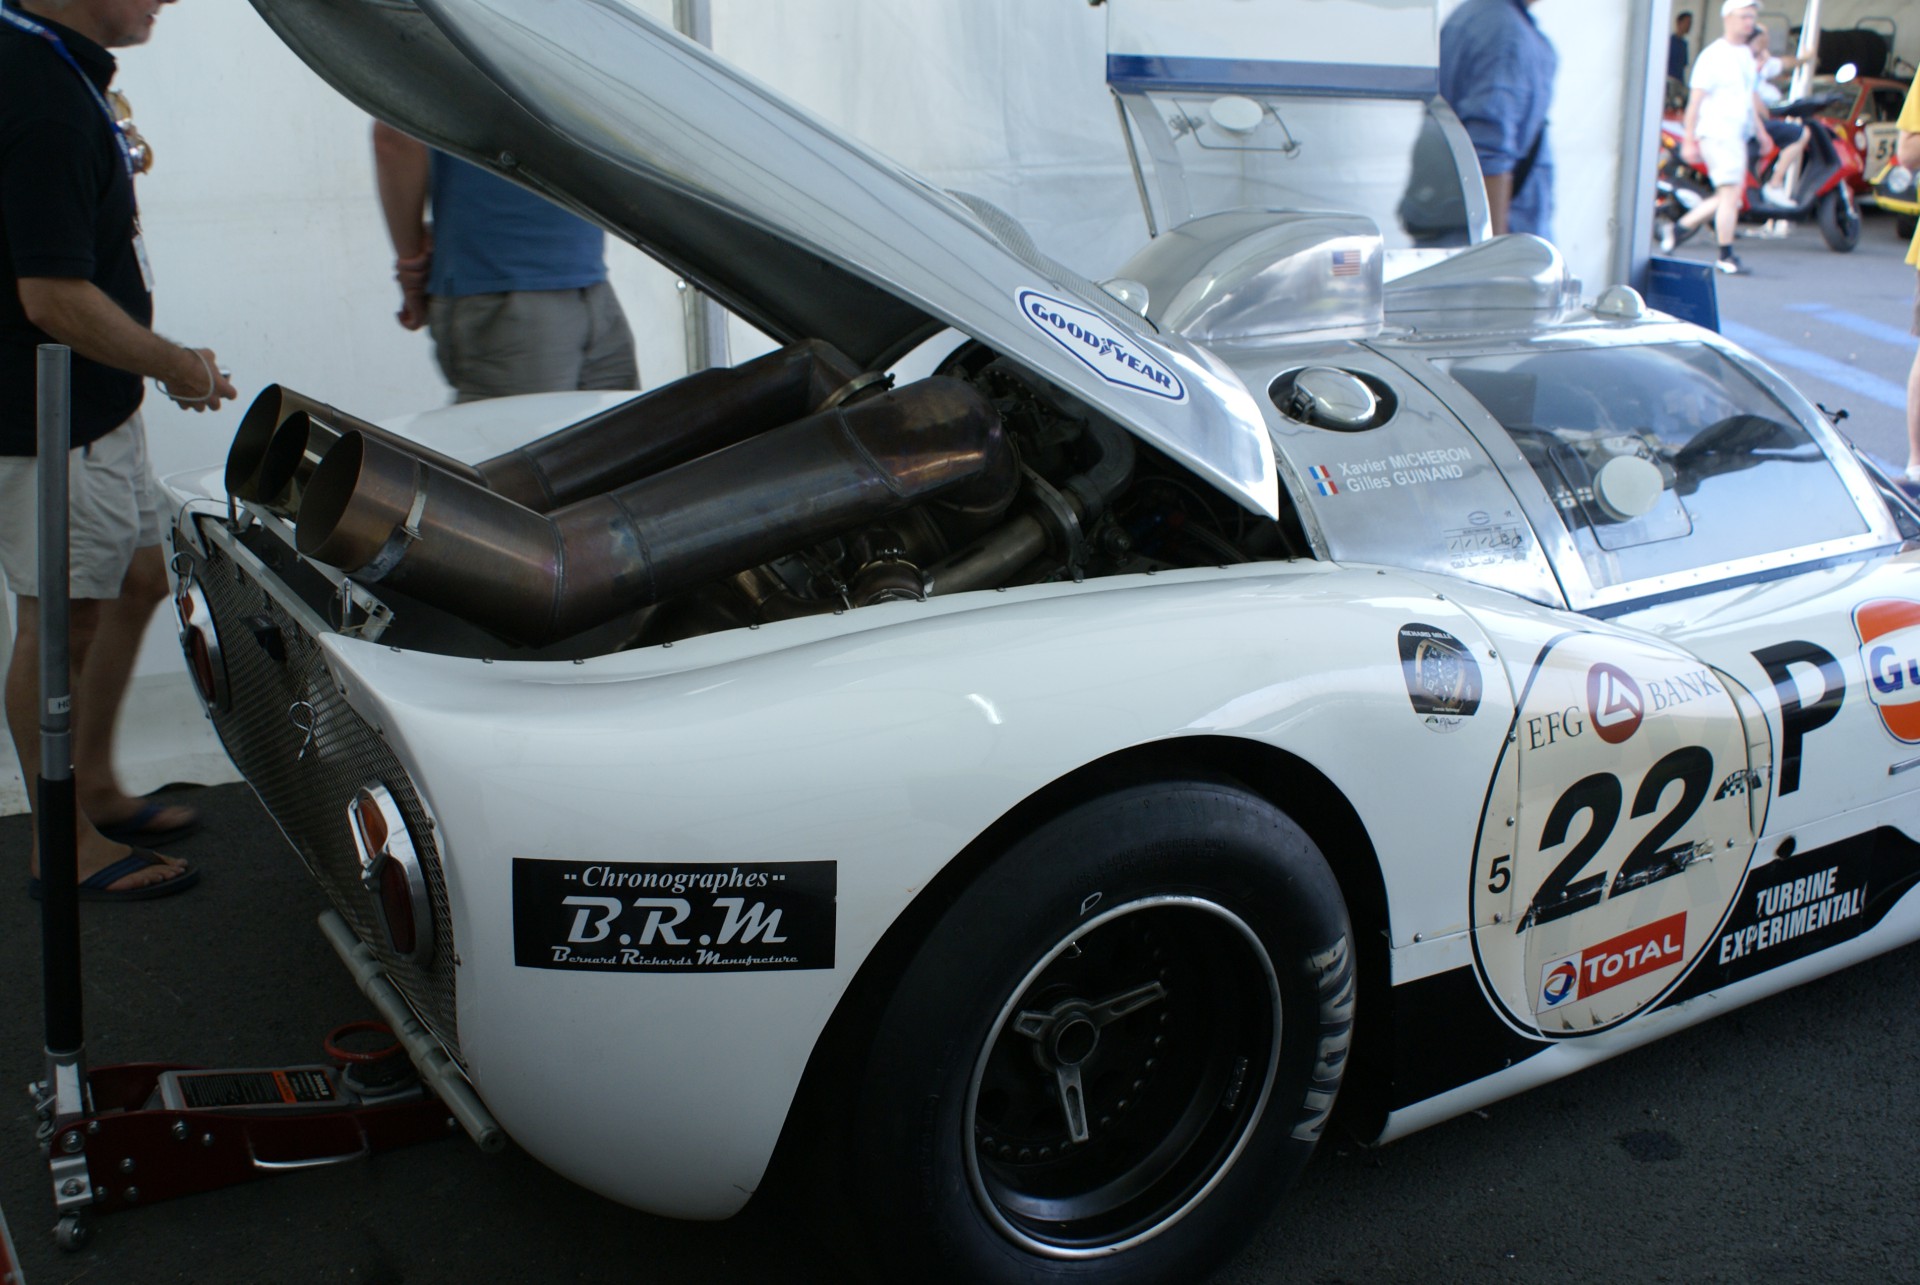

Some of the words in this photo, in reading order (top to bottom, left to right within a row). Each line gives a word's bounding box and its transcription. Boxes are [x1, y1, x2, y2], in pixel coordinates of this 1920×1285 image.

[1337, 459, 1387, 477] Xavier
[1389, 447, 1472, 471] MICHERON
[1346, 473, 1391, 492] Gilles
[1393, 464, 1463, 486] GUINAND
[1526, 706, 1583, 750] EFG
[1646, 669, 1722, 711] BANK
[1750, 640, 1846, 796] P
[1516, 746, 1714, 934] 22
[582, 866, 768, 893] Chronographes
[1488, 855, 1511, 893] 5
[1756, 866, 1838, 918] TURBINE
[1719, 888, 1860, 965] EXPERIMENTAL
[551, 946, 617, 965] Bernard
[620, 949, 693, 966] Richards
[696, 949, 799, 967] Manufacture
[1584, 934, 1681, 983] TOTAL
